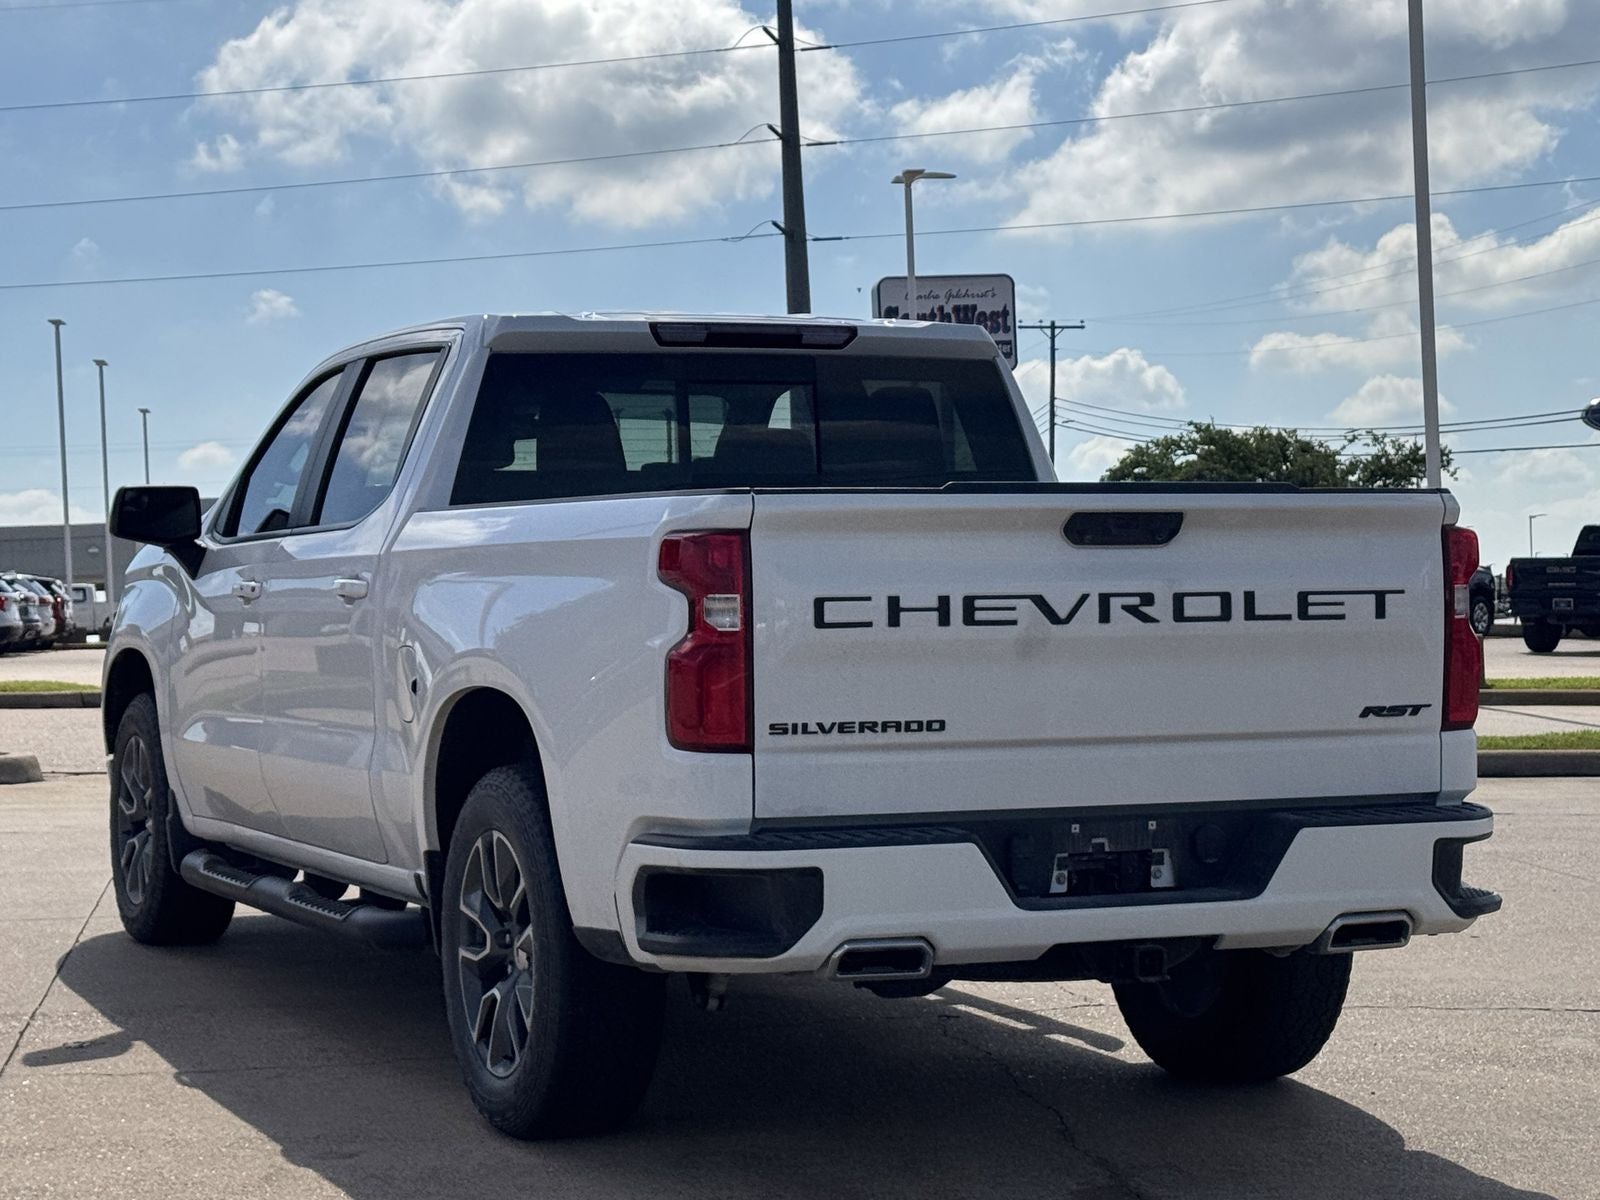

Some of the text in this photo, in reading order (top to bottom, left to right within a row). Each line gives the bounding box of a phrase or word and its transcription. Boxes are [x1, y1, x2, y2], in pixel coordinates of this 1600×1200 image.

[904, 289, 941, 301] Carlie
[814, 589, 1405, 629] CHEVROLET
[1359, 704, 1432, 718] RST
[768, 719, 946, 736] SILVERADO
